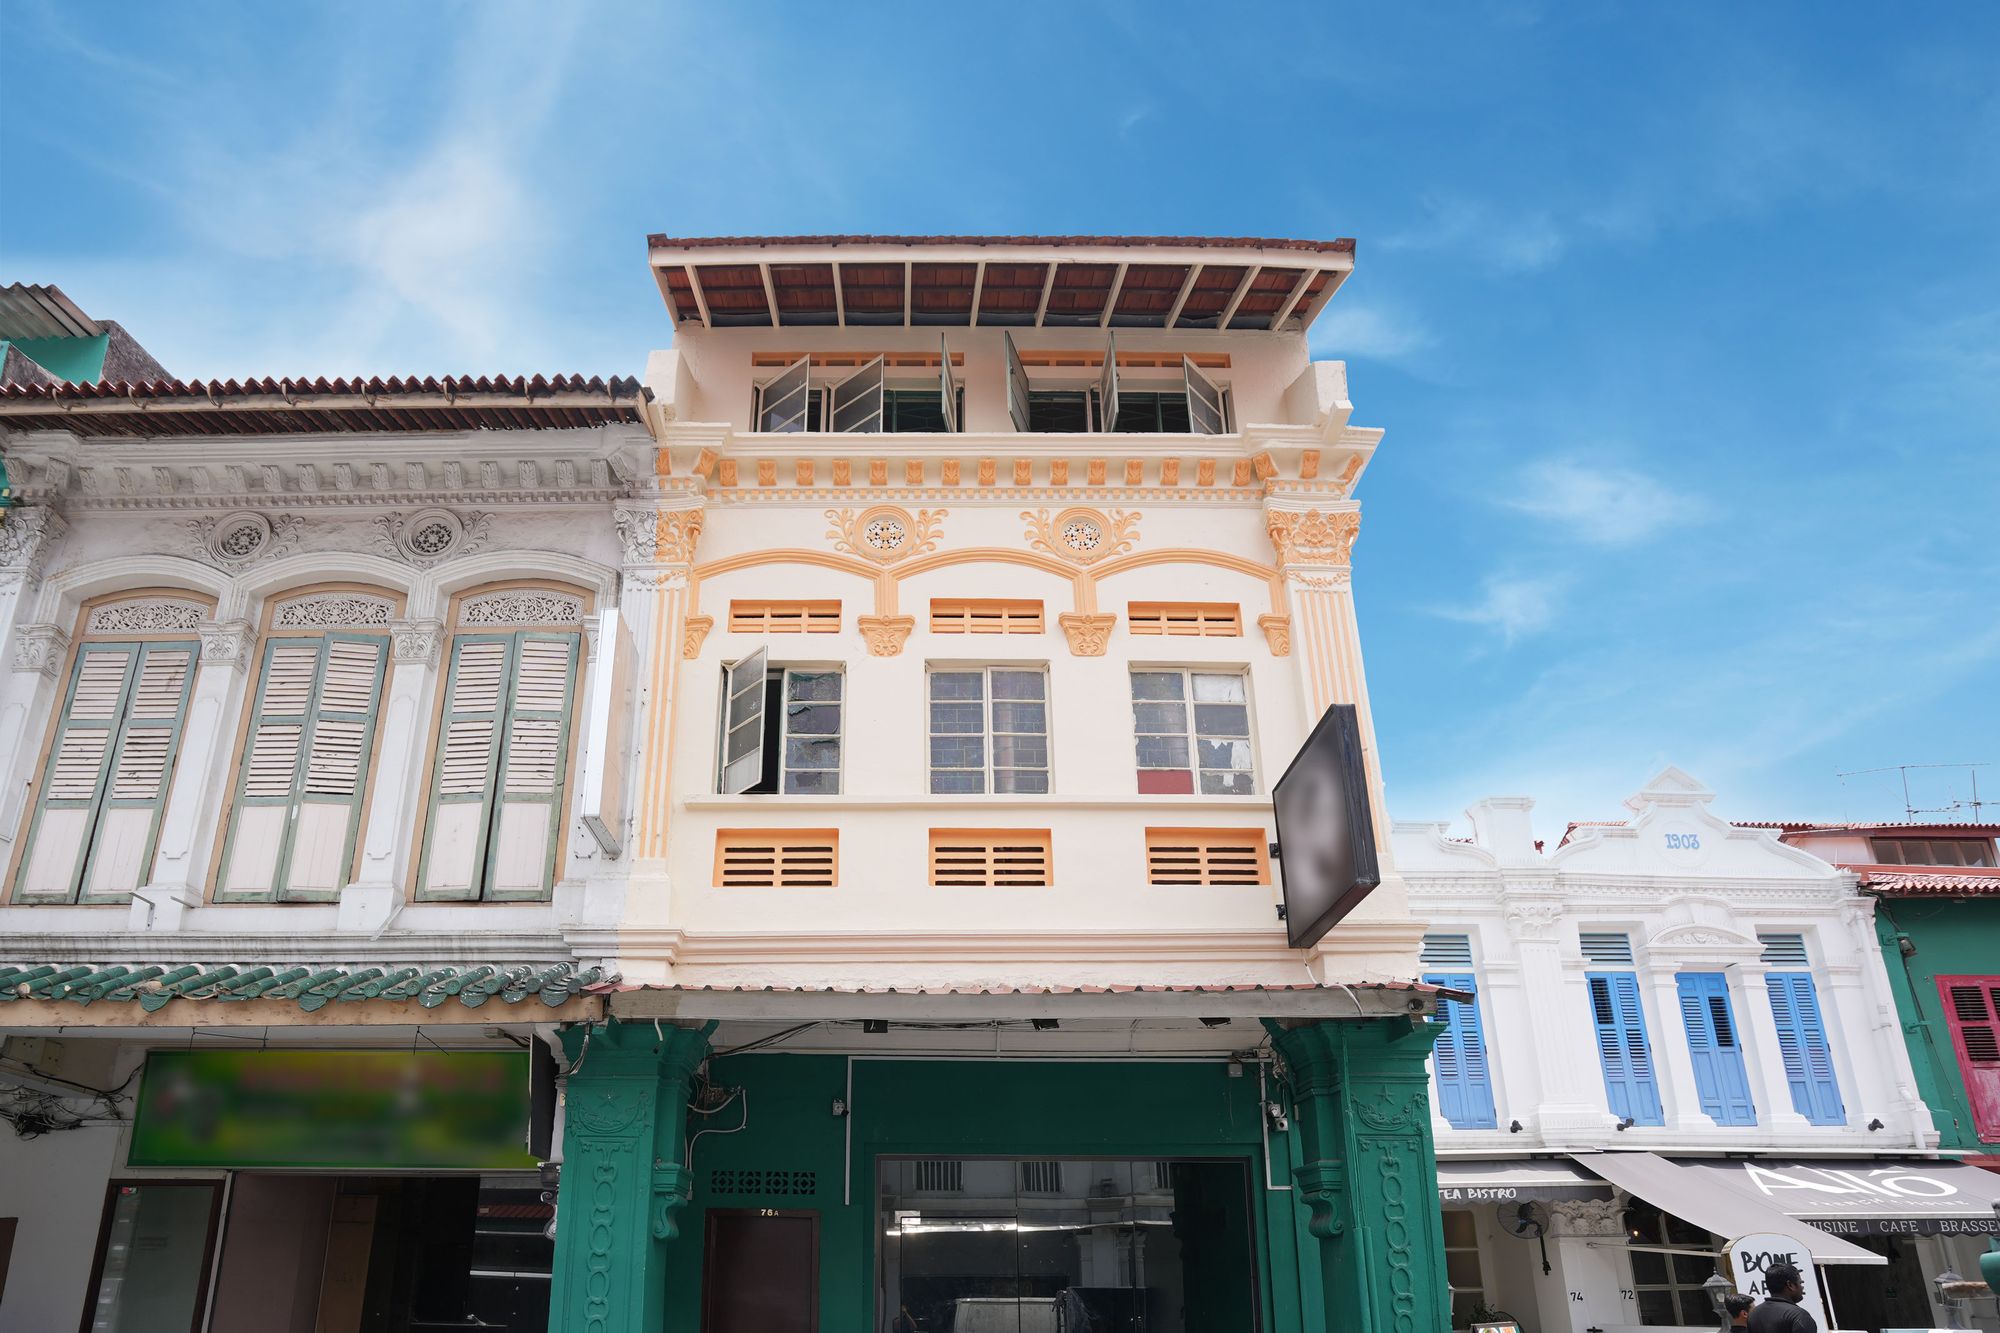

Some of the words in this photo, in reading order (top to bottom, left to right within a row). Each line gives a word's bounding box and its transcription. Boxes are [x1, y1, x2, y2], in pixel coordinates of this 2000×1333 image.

[1664, 833, 1700, 849] 1903
[1467, 1187, 1517, 1199] BISTRO
[760, 1208, 779, 1217] 76A
[1879, 1220, 1919, 1232] CAFE
[1570, 1291, 1584, 1302] 74
[1621, 1289, 1634, 1300] 72
